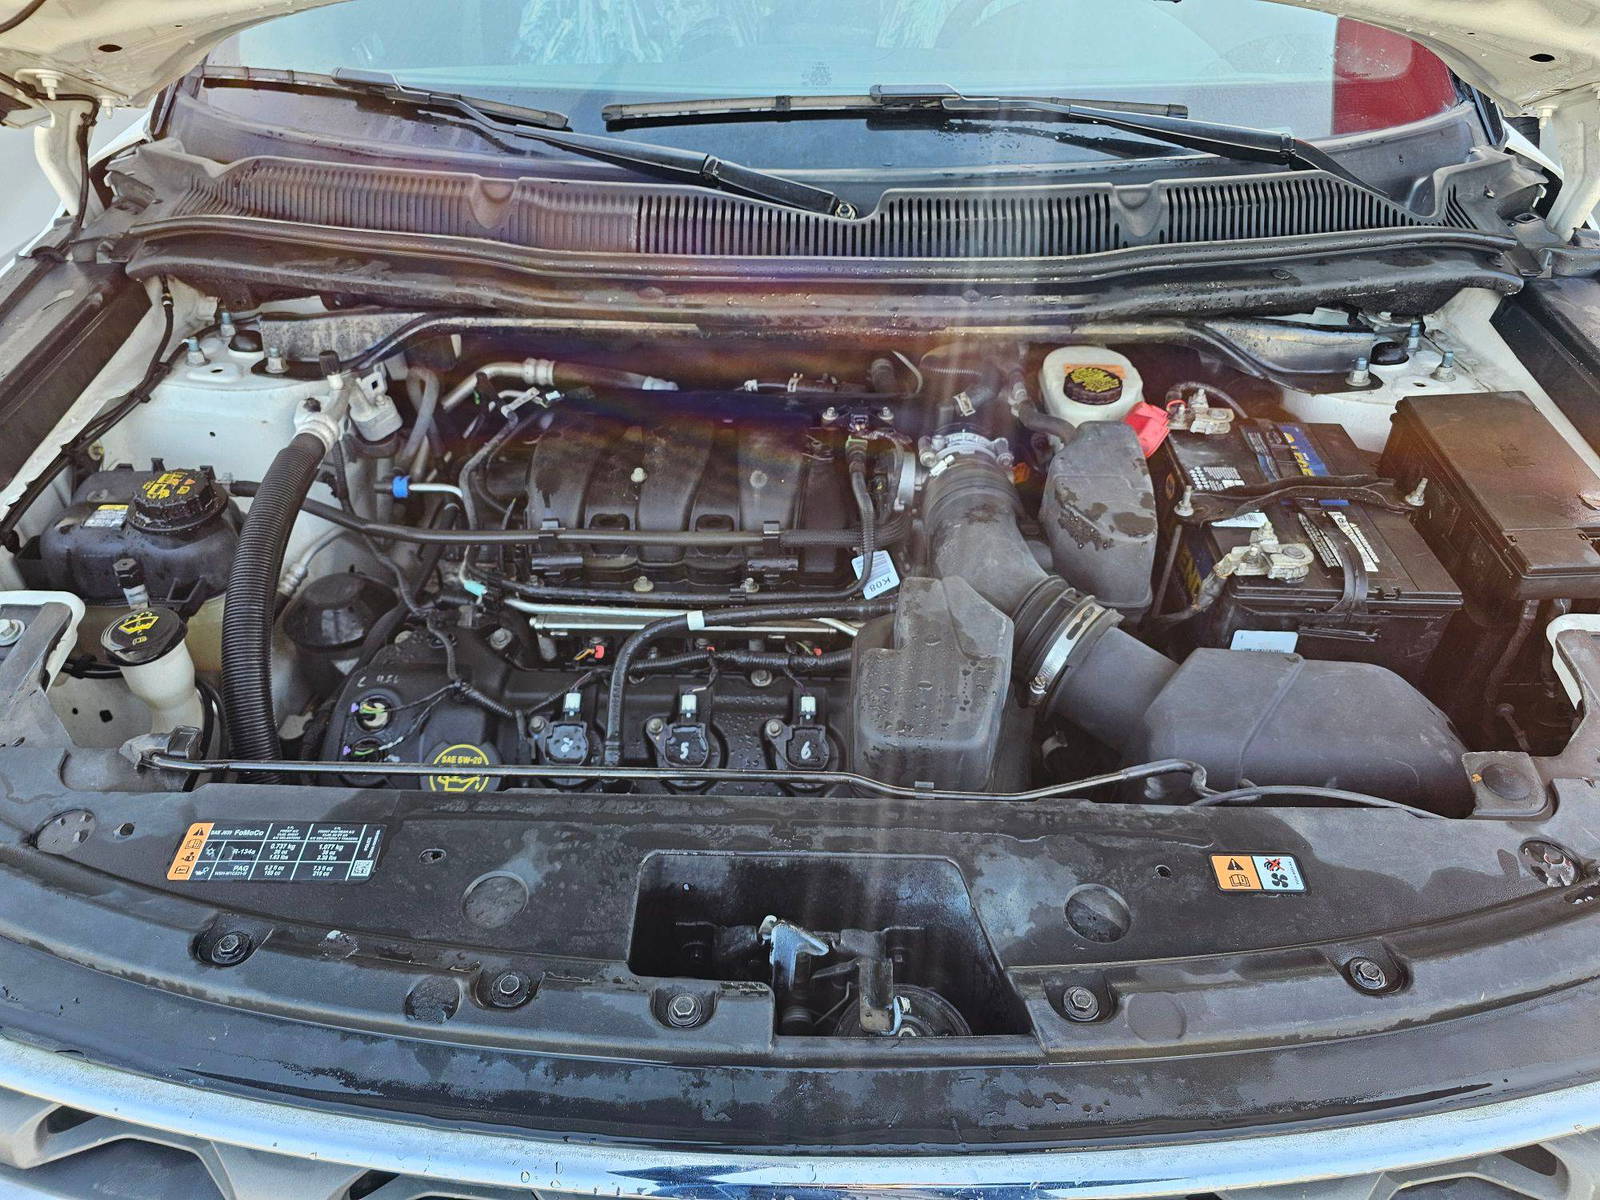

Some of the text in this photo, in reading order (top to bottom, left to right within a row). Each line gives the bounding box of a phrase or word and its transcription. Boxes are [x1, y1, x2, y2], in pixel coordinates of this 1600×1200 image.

[869, 576, 891, 592] K08
[680, 741, 689, 760] 5
[800, 740, 811, 760] 6
[441, 755, 482, 764] SAE 5W-20
[335, 844, 344, 852] kg
